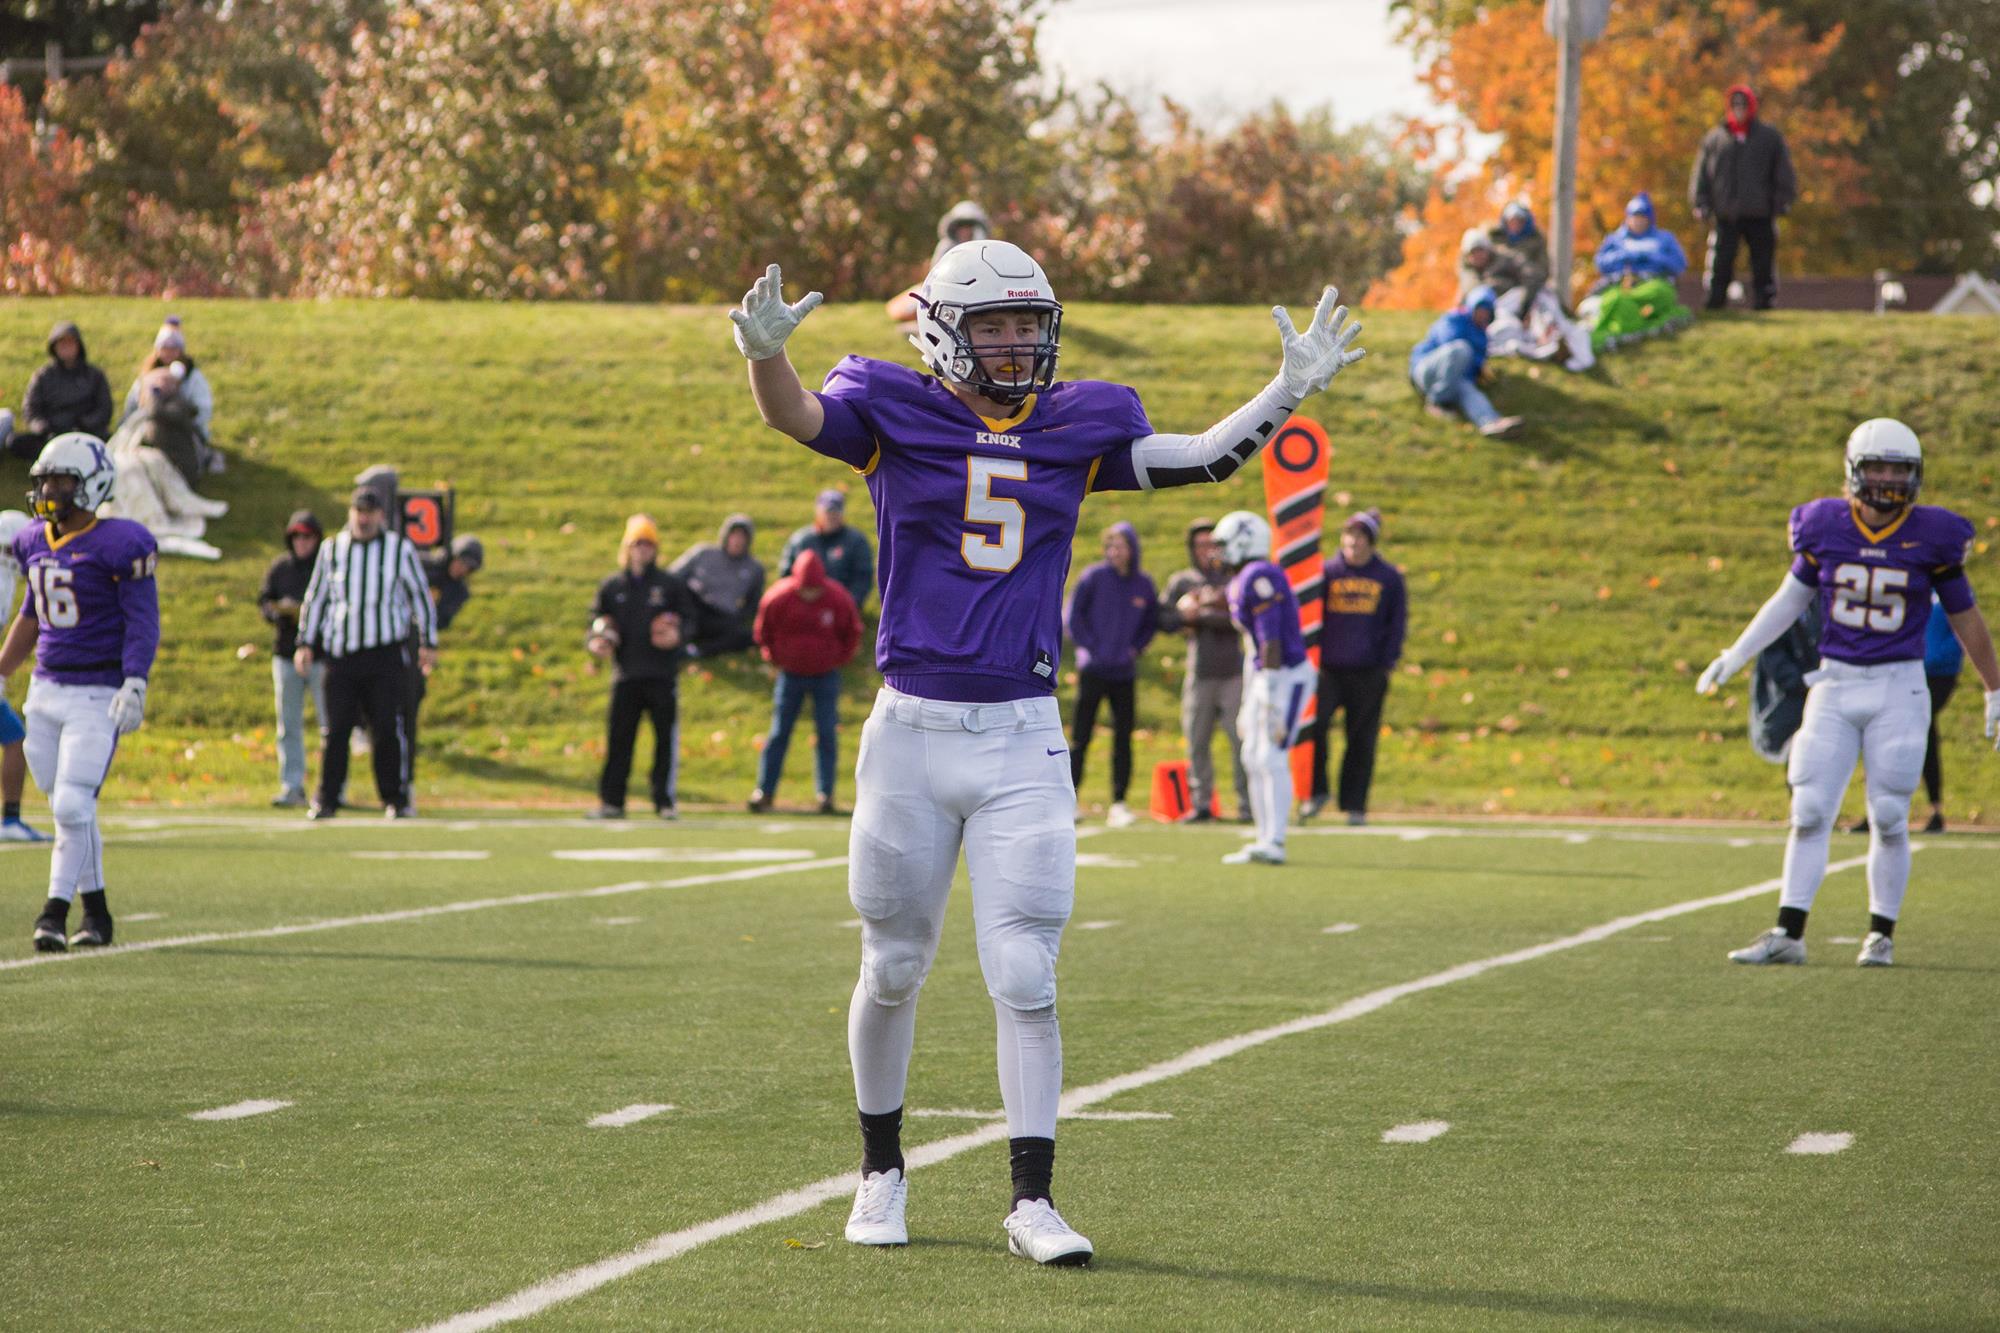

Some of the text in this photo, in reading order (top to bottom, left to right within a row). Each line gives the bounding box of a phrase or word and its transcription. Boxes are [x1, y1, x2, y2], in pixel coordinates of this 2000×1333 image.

[1007, 290, 1039, 298] Riddell
[976, 432, 1022, 449] KNOX
[405, 497, 440, 545] 3
[961, 454, 1028, 573] 5
[29, 565, 79, 629] 16
[1832, 563, 1909, 633] 25
[1168, 769, 1185, 813] 1
